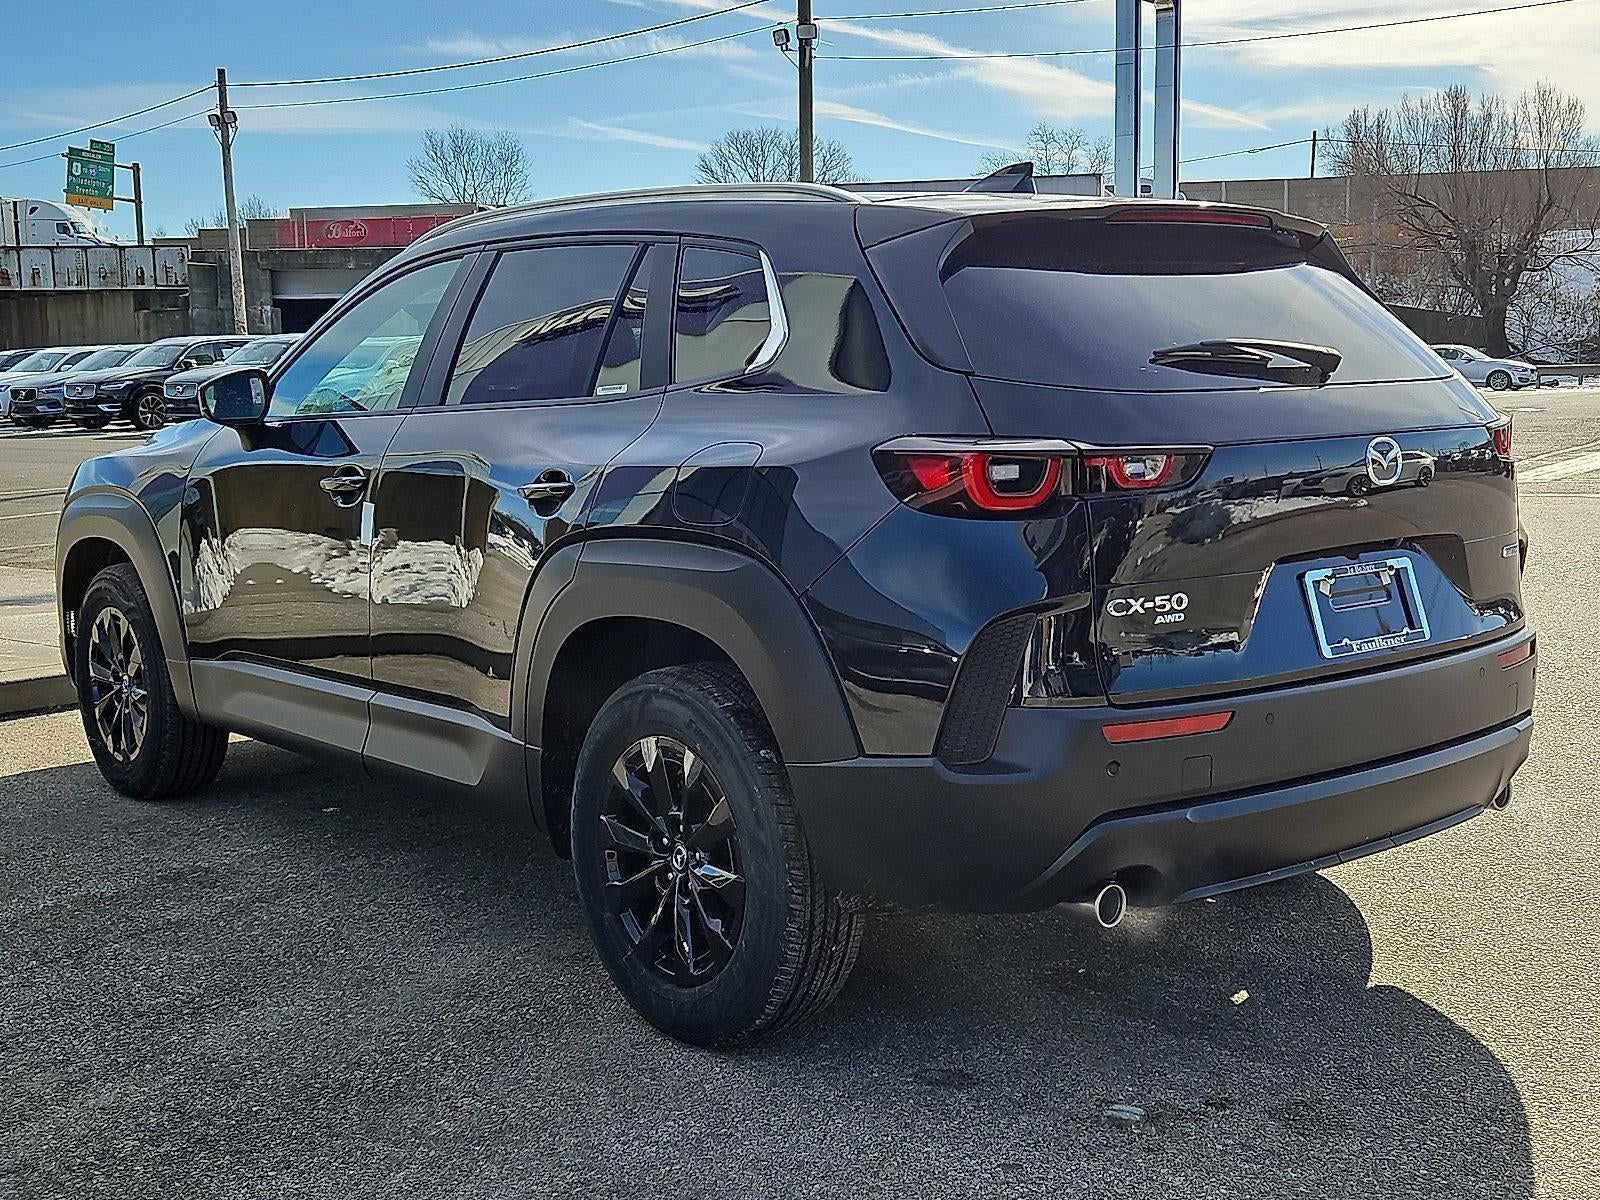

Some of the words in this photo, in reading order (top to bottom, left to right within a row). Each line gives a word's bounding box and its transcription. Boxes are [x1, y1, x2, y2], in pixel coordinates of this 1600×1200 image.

[68, 175, 106, 188] Philadelphia
[75, 186, 99, 196] Trenton
[1106, 592, 1189, 617] CX-50
[1153, 612, 1185, 625] AWD
[1352, 635, 1408, 652] Faulkner
